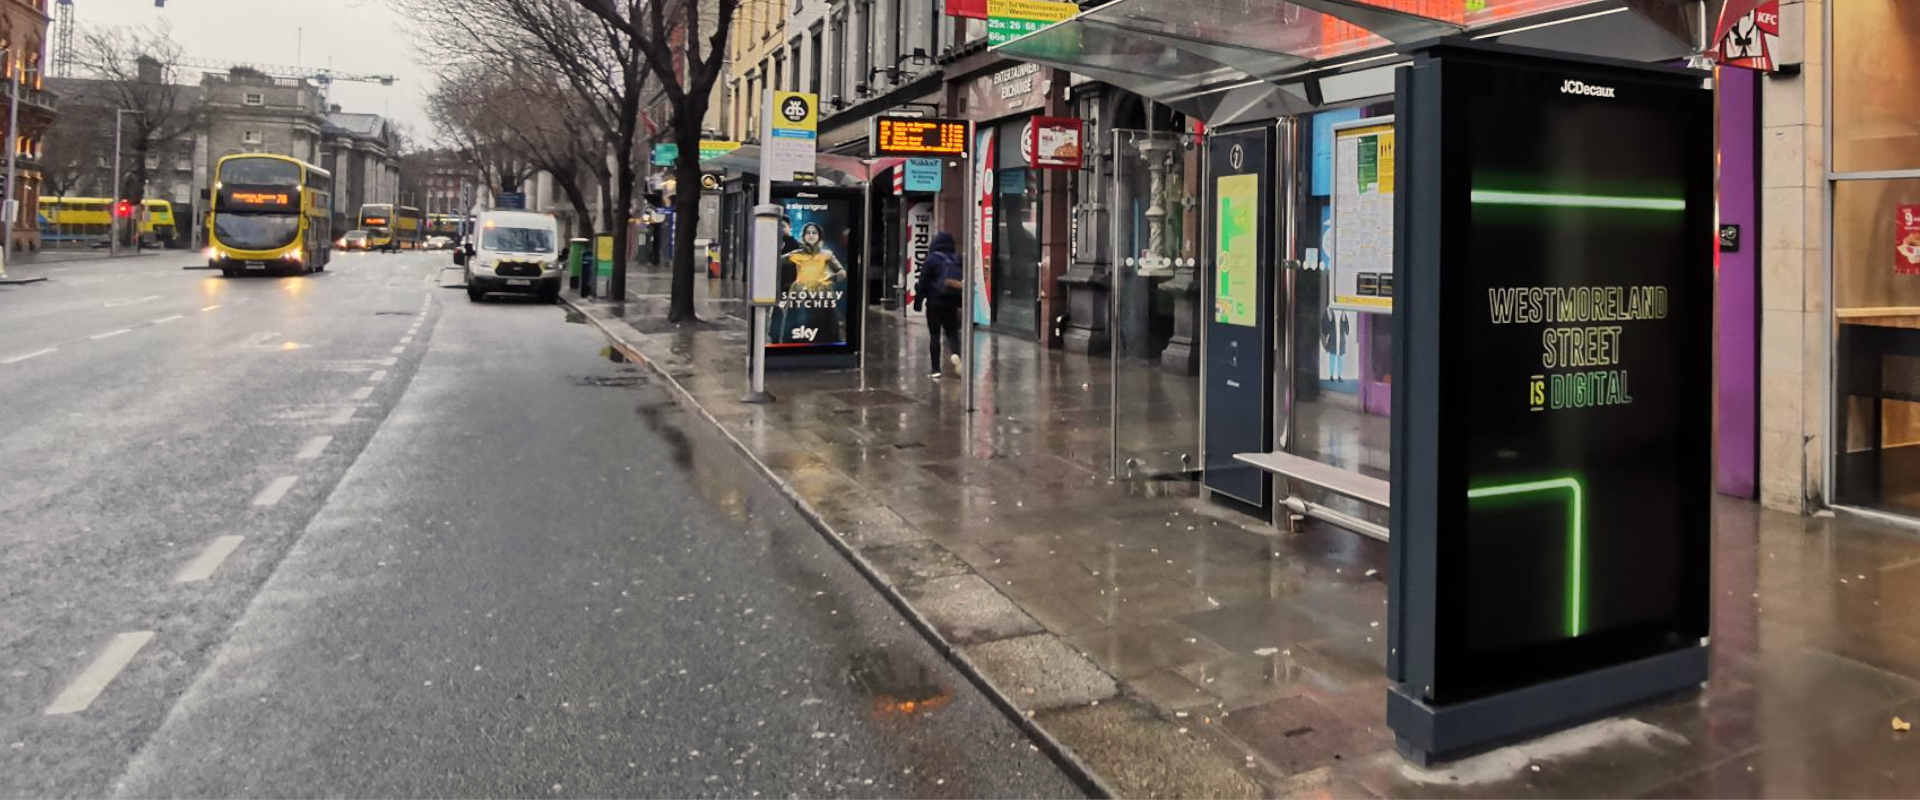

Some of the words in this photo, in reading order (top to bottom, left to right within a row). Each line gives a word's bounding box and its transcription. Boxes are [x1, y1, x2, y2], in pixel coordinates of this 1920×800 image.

[1757, 11, 1777, 26] KFC
[993, 63, 1040, 85] ENTERTAINMENT
[1001, 76, 1032, 100] EXCHANGE
[1560, 79, 1615, 98] JCDecaux
[804, 204, 828, 212] original
[914, 223, 930, 287] FRIDA
[781, 290, 844, 300] SCOVERY
[1489, 286, 1668, 324] WESTMORELAND
[791, 325, 819, 341] sky
[1542, 326, 1622, 368] STREET
[1530, 380, 1545, 405] IS
[1551, 370, 1632, 409] DIGITAL
